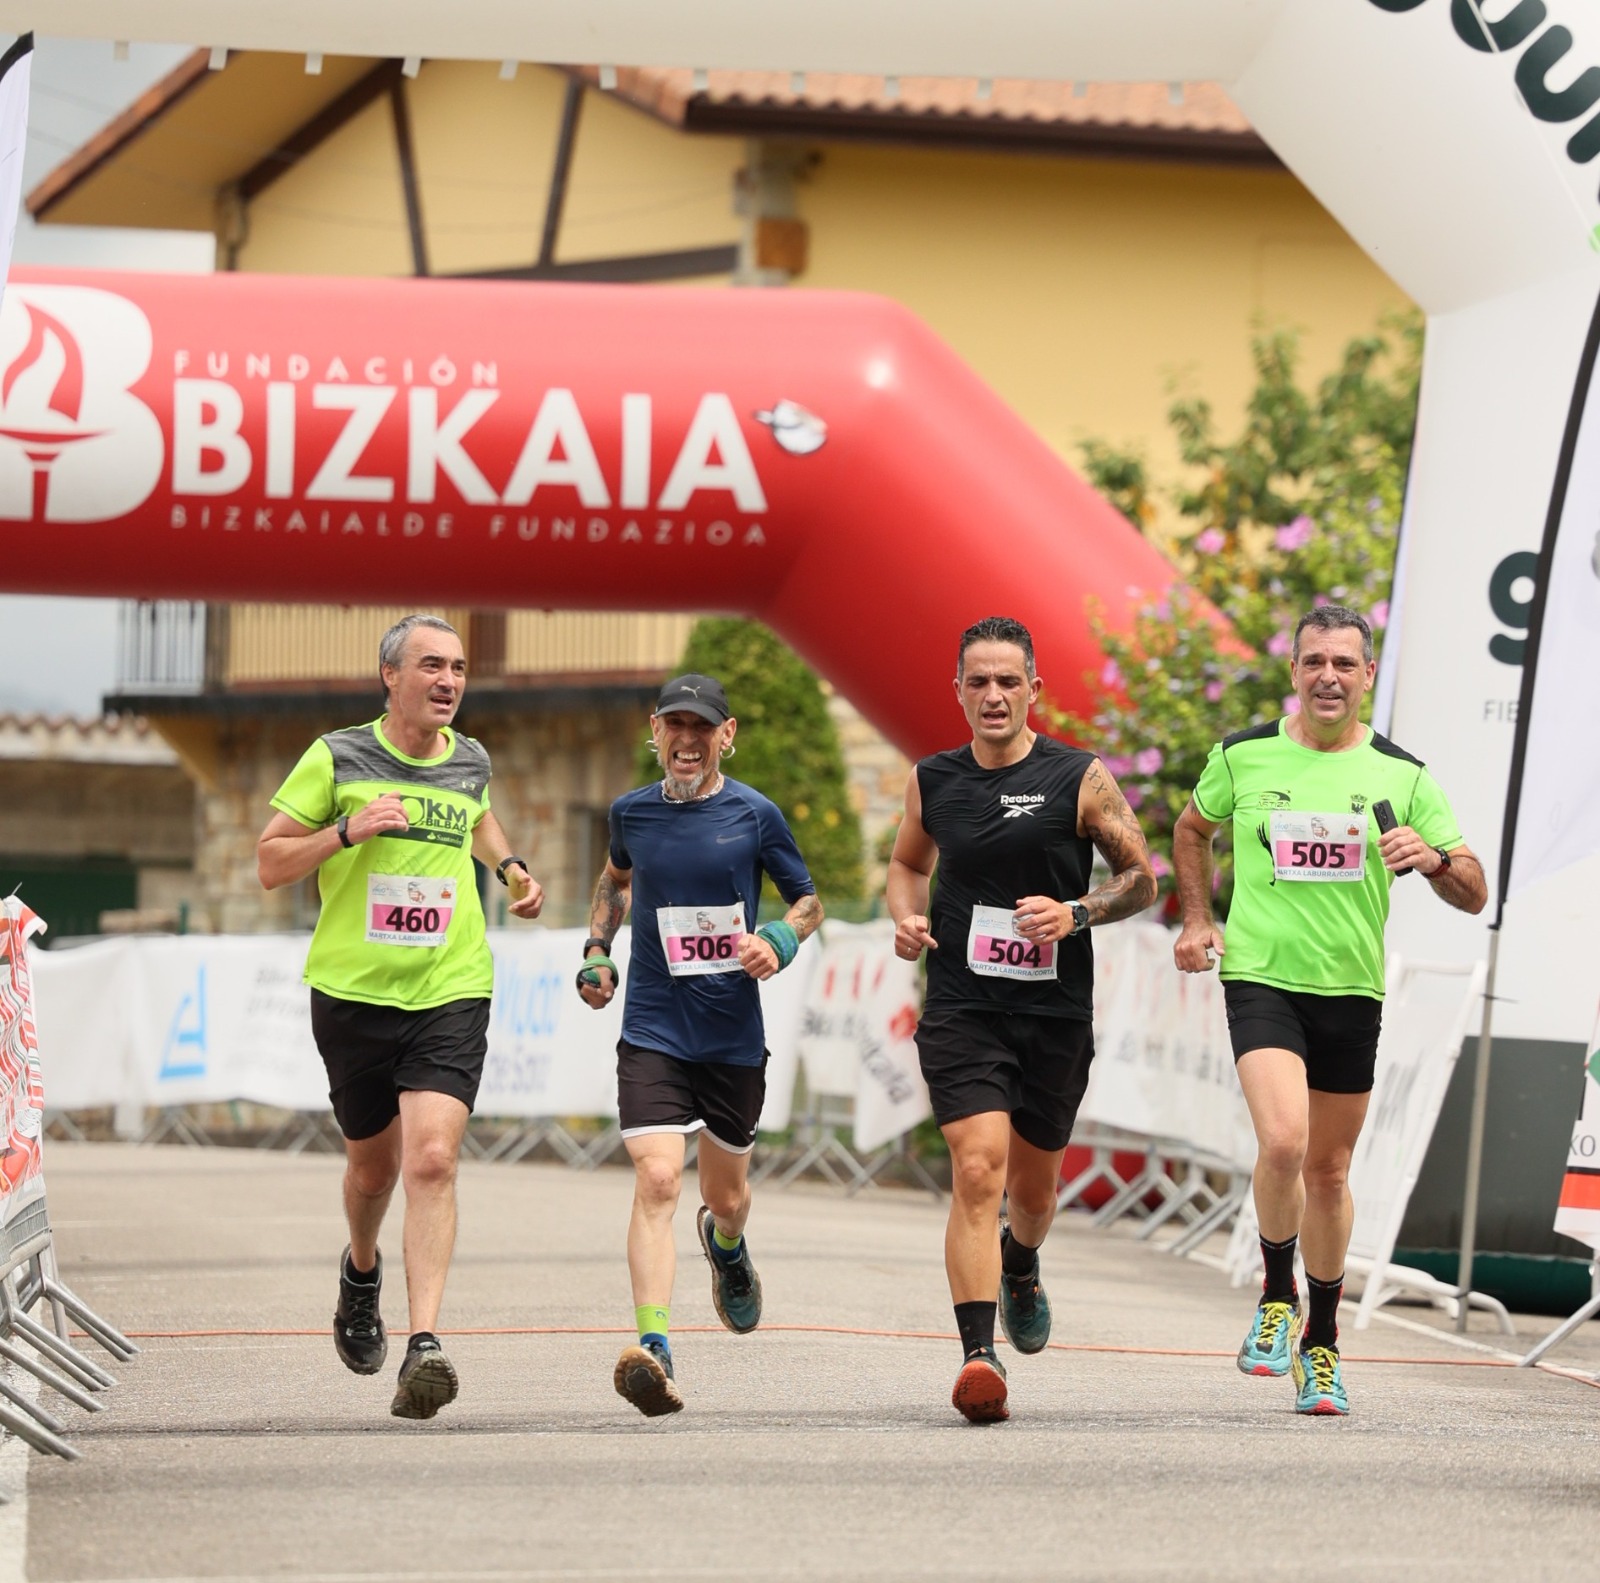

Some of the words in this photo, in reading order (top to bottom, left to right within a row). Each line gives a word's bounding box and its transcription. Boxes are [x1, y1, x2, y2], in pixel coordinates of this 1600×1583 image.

[174, 349, 498, 386] FUNDACIÓN
[172, 378, 768, 513] BIZKAIA
[170, 504, 454, 539] BIZKAIALDE
[490, 514, 767, 545] FUNDAZIOA
[1000, 794, 1045, 804] Reebok
[426, 817, 467, 833] BILBAO
[1291, 841, 1346, 869] 505
[386, 906, 440, 933] 460
[680, 935, 732, 961] 506
[988, 938, 1041, 968] 504
[969, 962, 998, 972] MARTXA
[1000, 966, 1054, 977] LABURRA/CORTA
